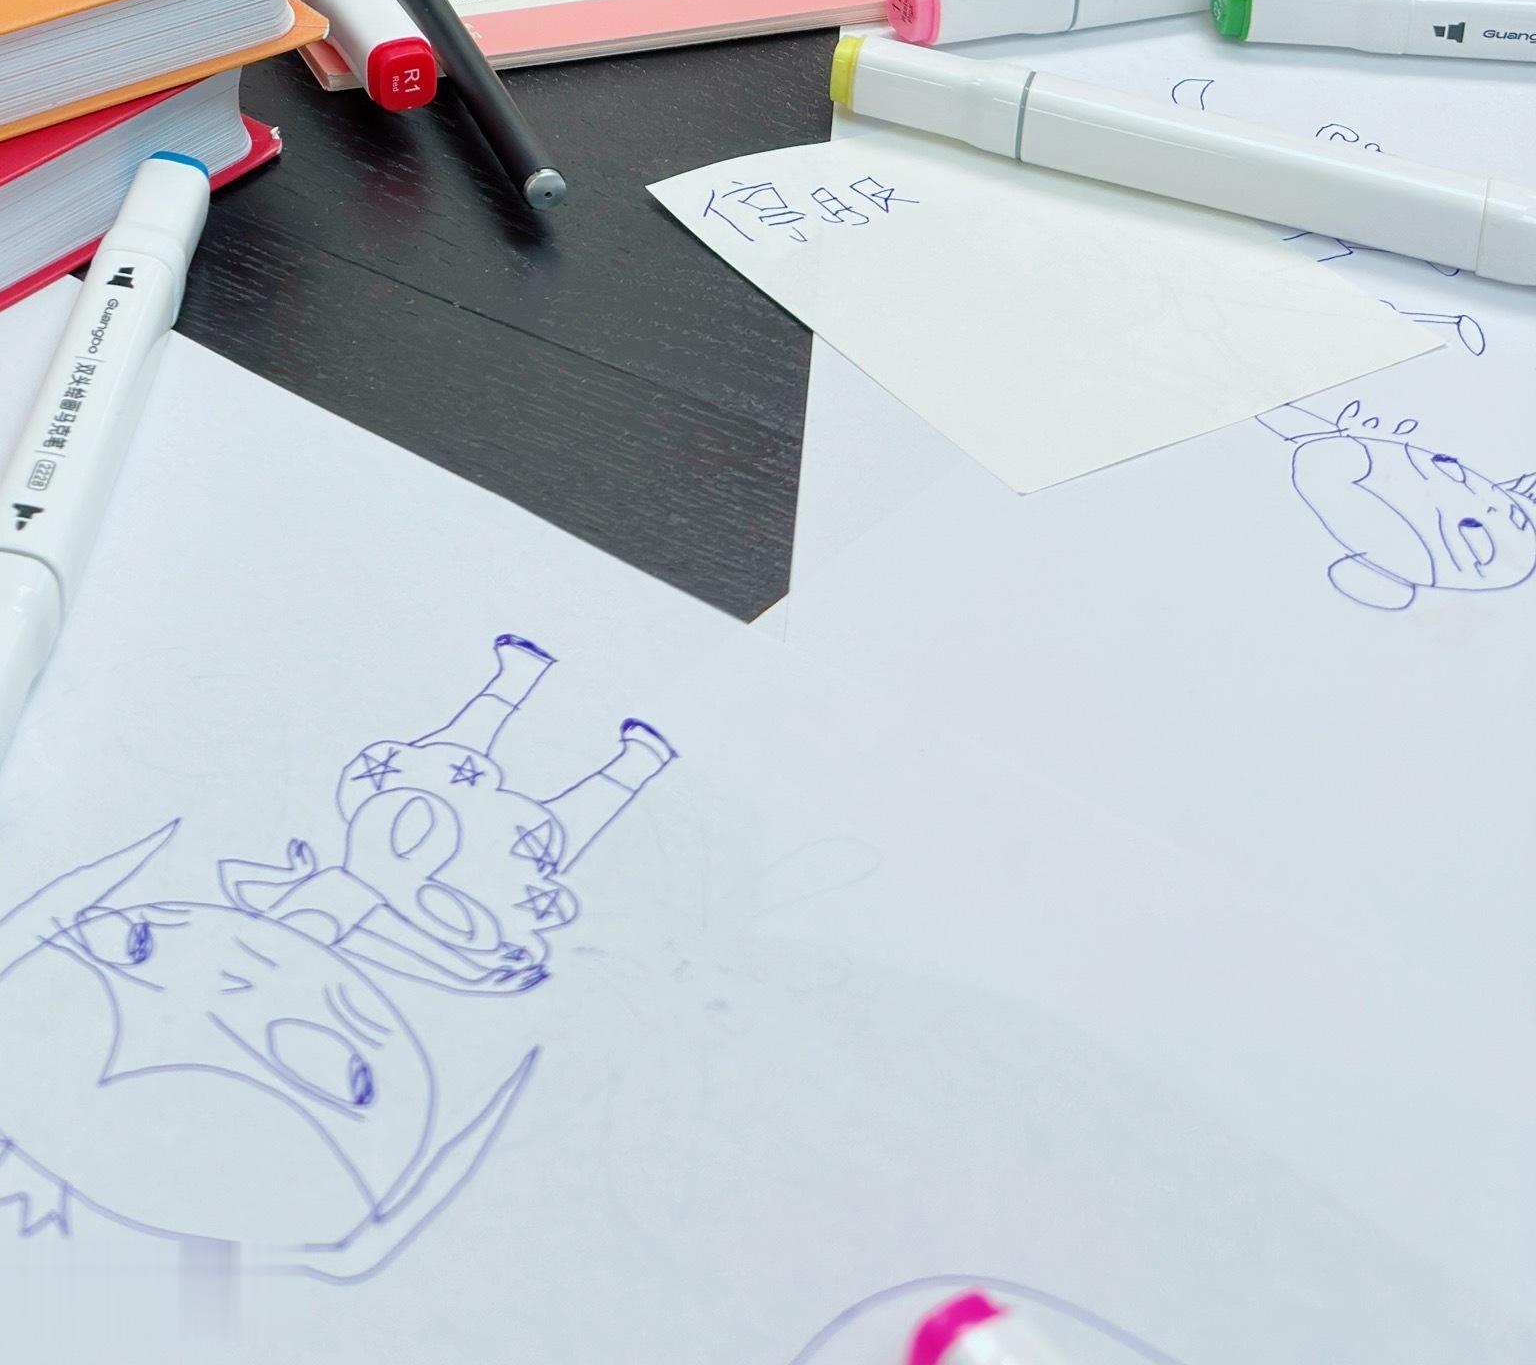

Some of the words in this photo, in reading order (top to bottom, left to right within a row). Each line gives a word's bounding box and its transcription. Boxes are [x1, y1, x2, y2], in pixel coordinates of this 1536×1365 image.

[402, 66, 422, 95] R1
[88, 297, 119, 355] Guangbo
[42, 361, 86, 451] 双头绘画马克笔
